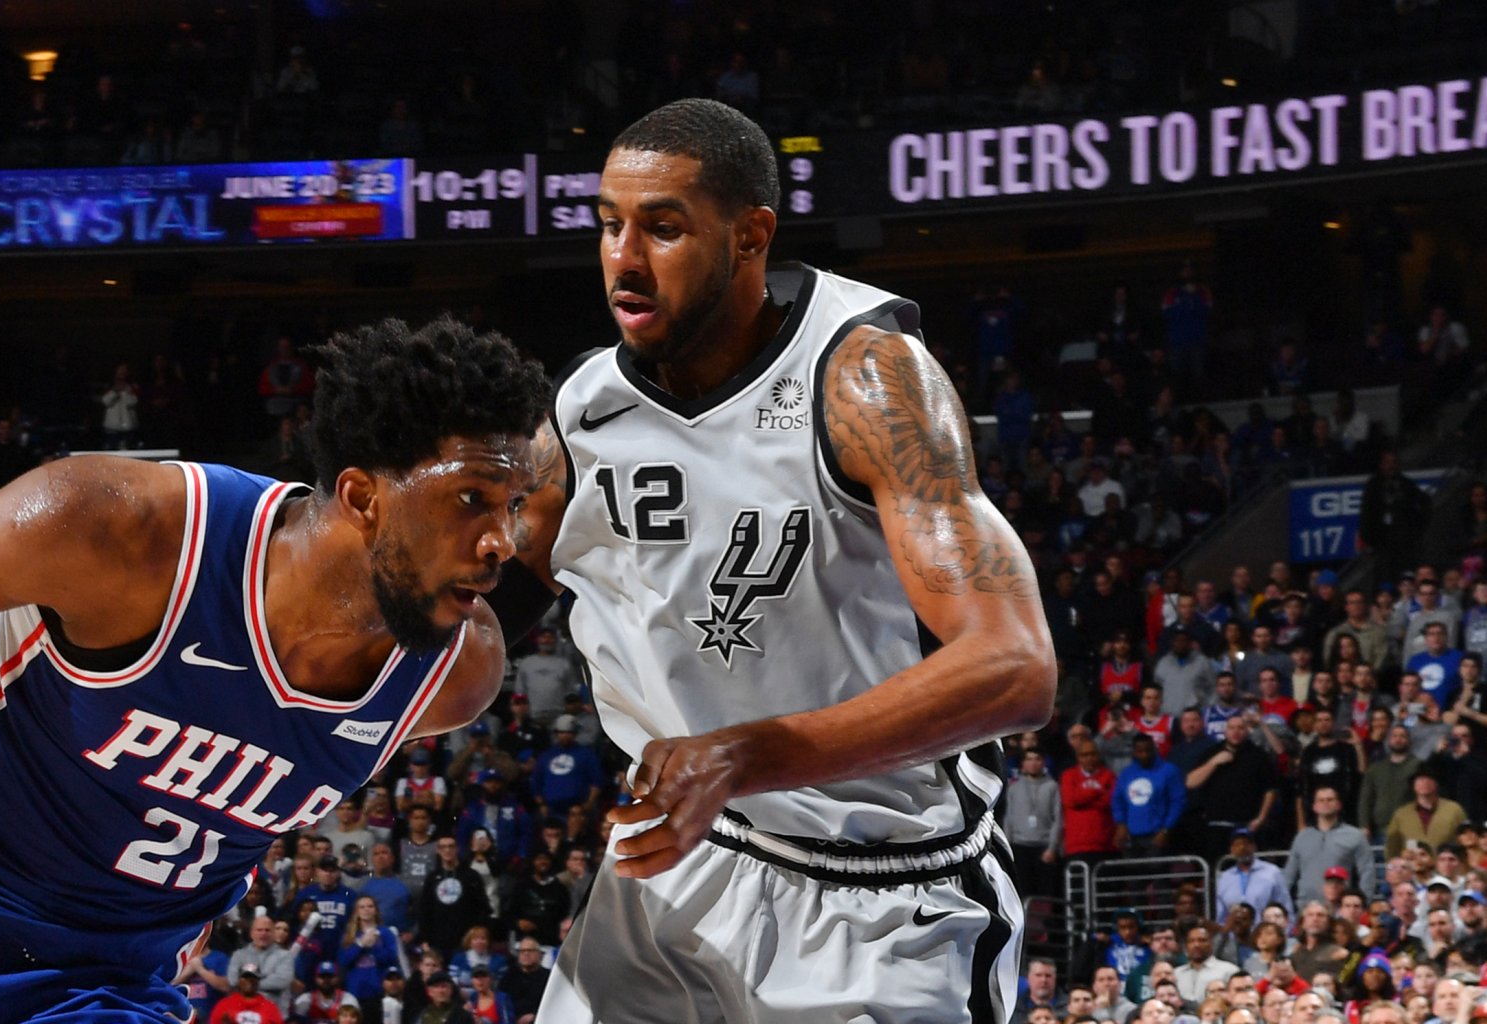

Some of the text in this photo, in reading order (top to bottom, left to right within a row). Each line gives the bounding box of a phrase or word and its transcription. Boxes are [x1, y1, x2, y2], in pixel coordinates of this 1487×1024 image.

[889, 119, 1110, 203] CHEERS
[1121, 112, 1197, 185] TO
[1211, 95, 1347, 178] FAST
[220, 176, 292, 199] JUNE
[298, 174, 339, 197] 20
[354, 173, 396, 196] 23
[411, 168, 525, 202] 10:19
[756, 407, 809, 430] Frost
[594, 461, 690, 544] 12
[1299, 526, 1345, 557] 117
[81, 708, 344, 833] PHILA
[113, 806, 227, 890] 21
